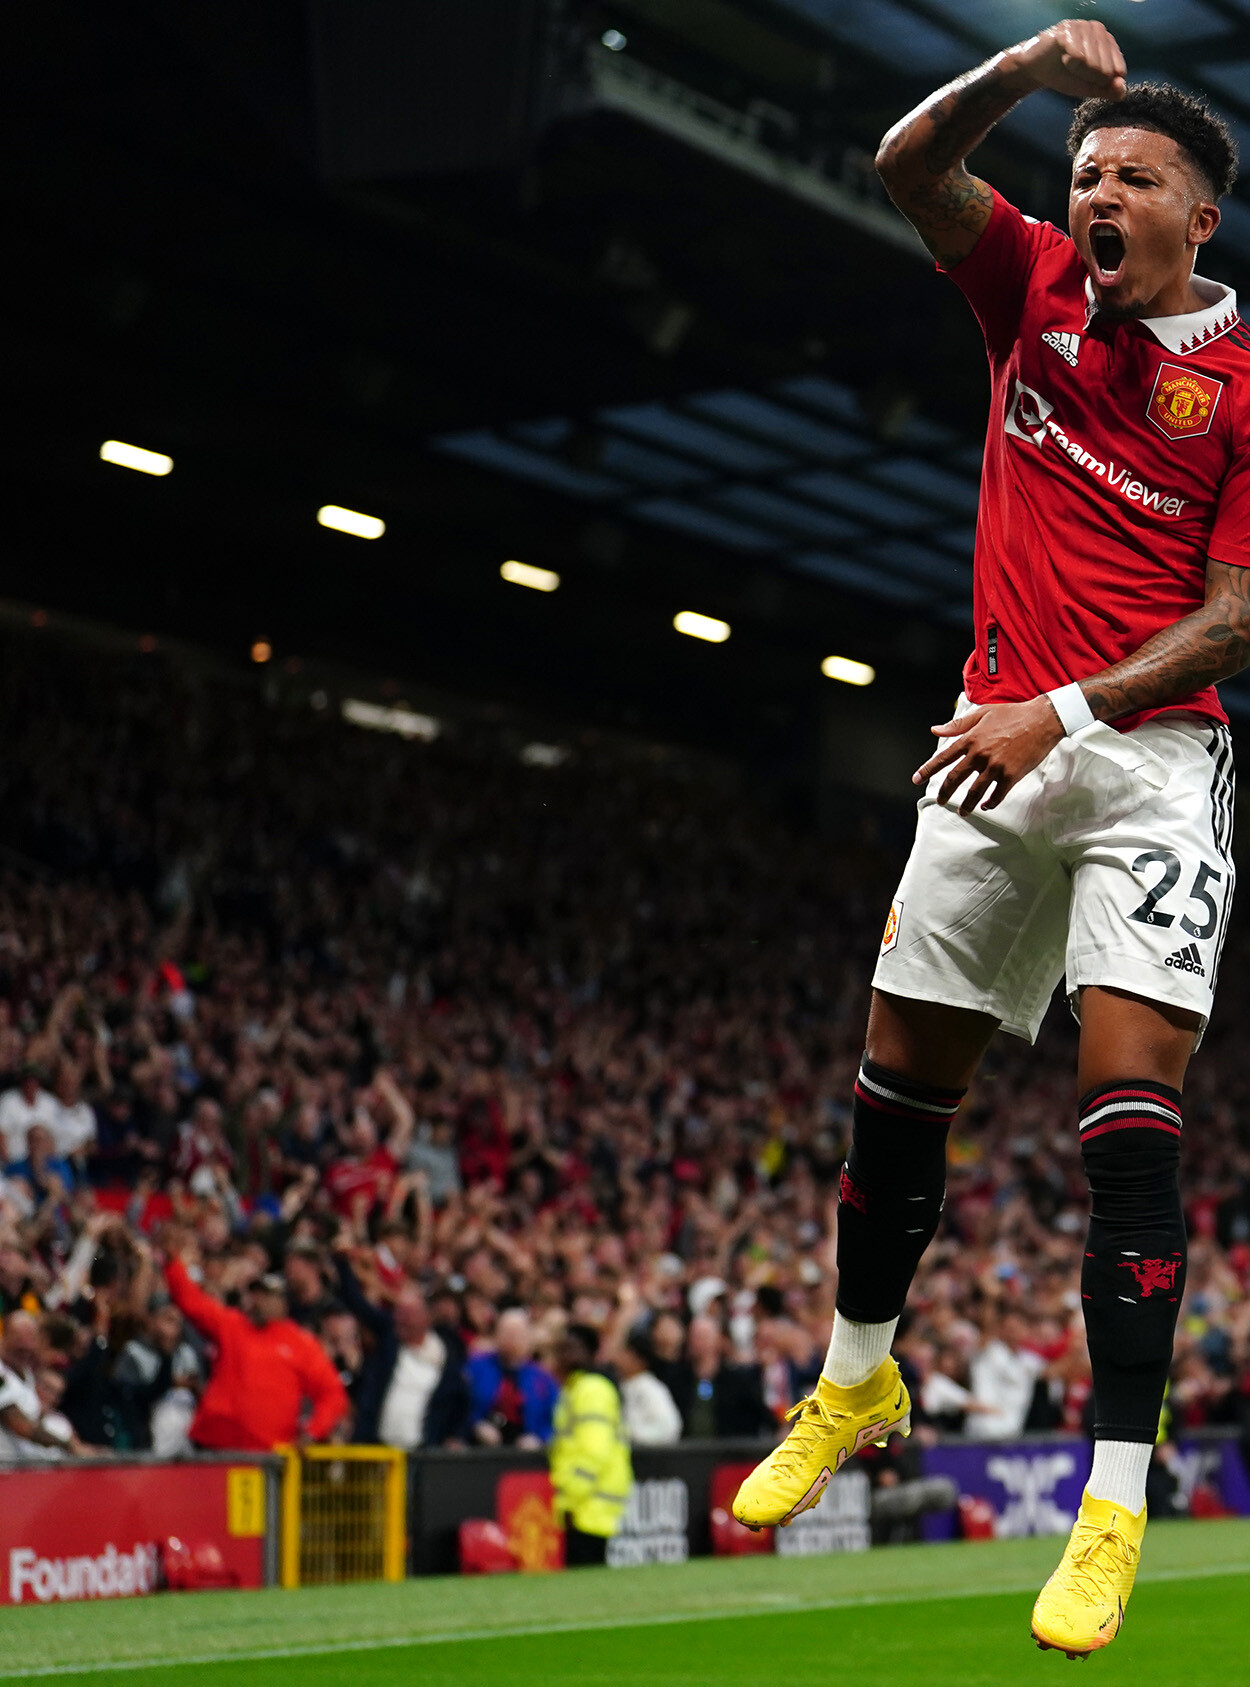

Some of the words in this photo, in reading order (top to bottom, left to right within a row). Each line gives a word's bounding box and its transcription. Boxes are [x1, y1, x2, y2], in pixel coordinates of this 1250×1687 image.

[1041, 333, 1079, 367] adidas
[1165, 380, 1206, 403] MANCHESTER
[1164, 412, 1193, 426] UNITED
[1046, 420, 1189, 517] TeamViewer
[1127, 851, 1221, 940] 25
[1165, 956, 1206, 977] adidas
